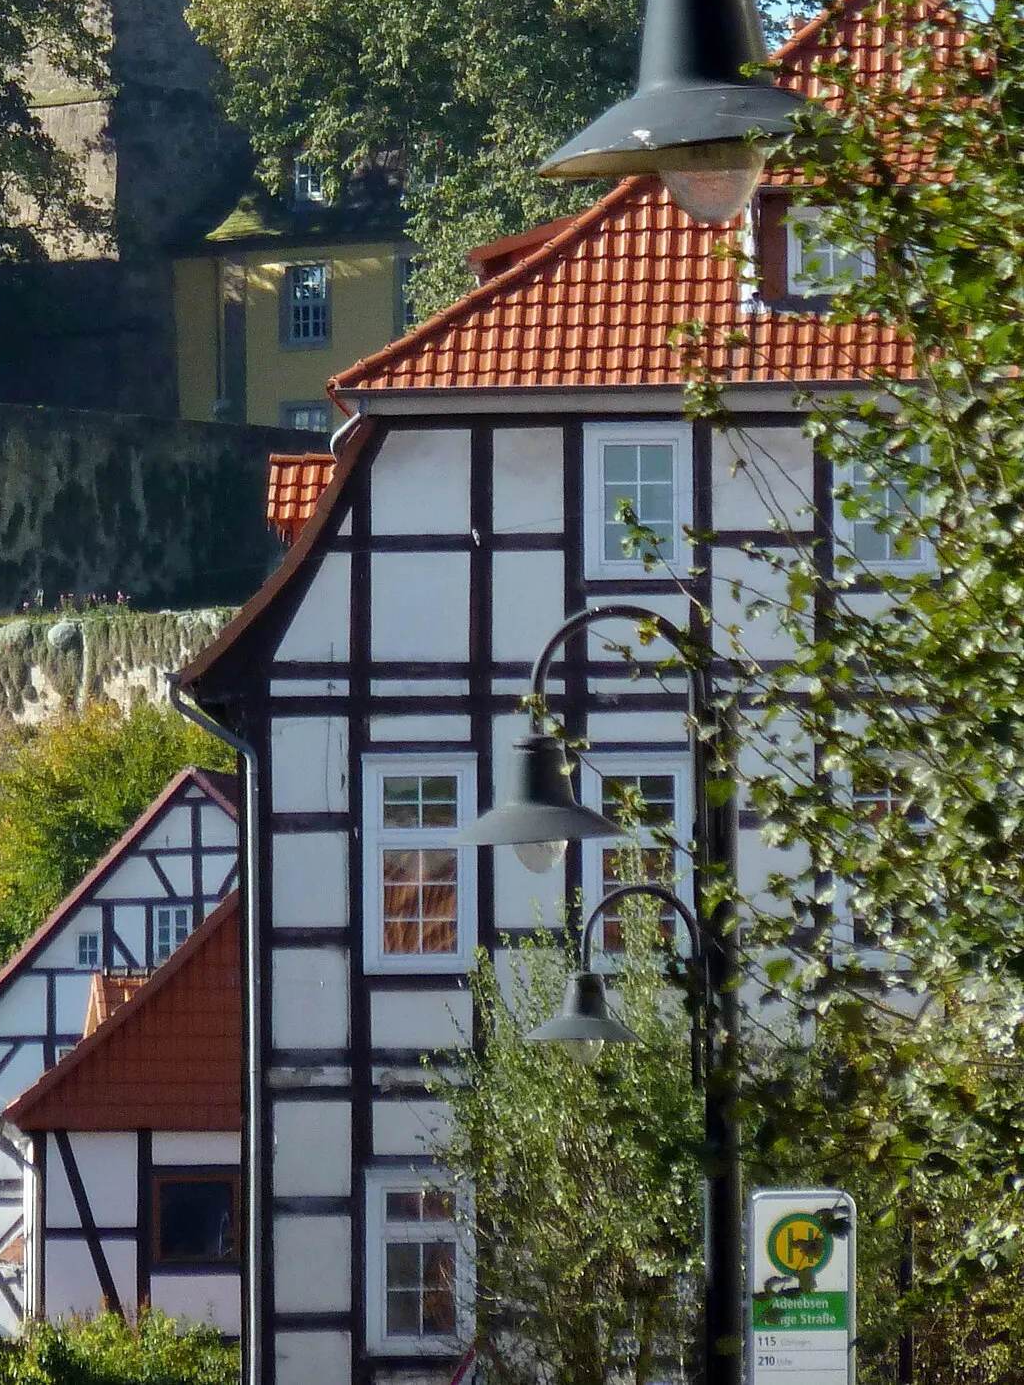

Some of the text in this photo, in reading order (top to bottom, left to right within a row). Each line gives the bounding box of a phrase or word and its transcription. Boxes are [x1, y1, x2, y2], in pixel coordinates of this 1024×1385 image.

[787, 1227, 815, 1264] H
[800, 1313, 836, 1325] Straße
[757, 1336, 776, 1347] 115
[757, 1356, 775, 1366] 210
